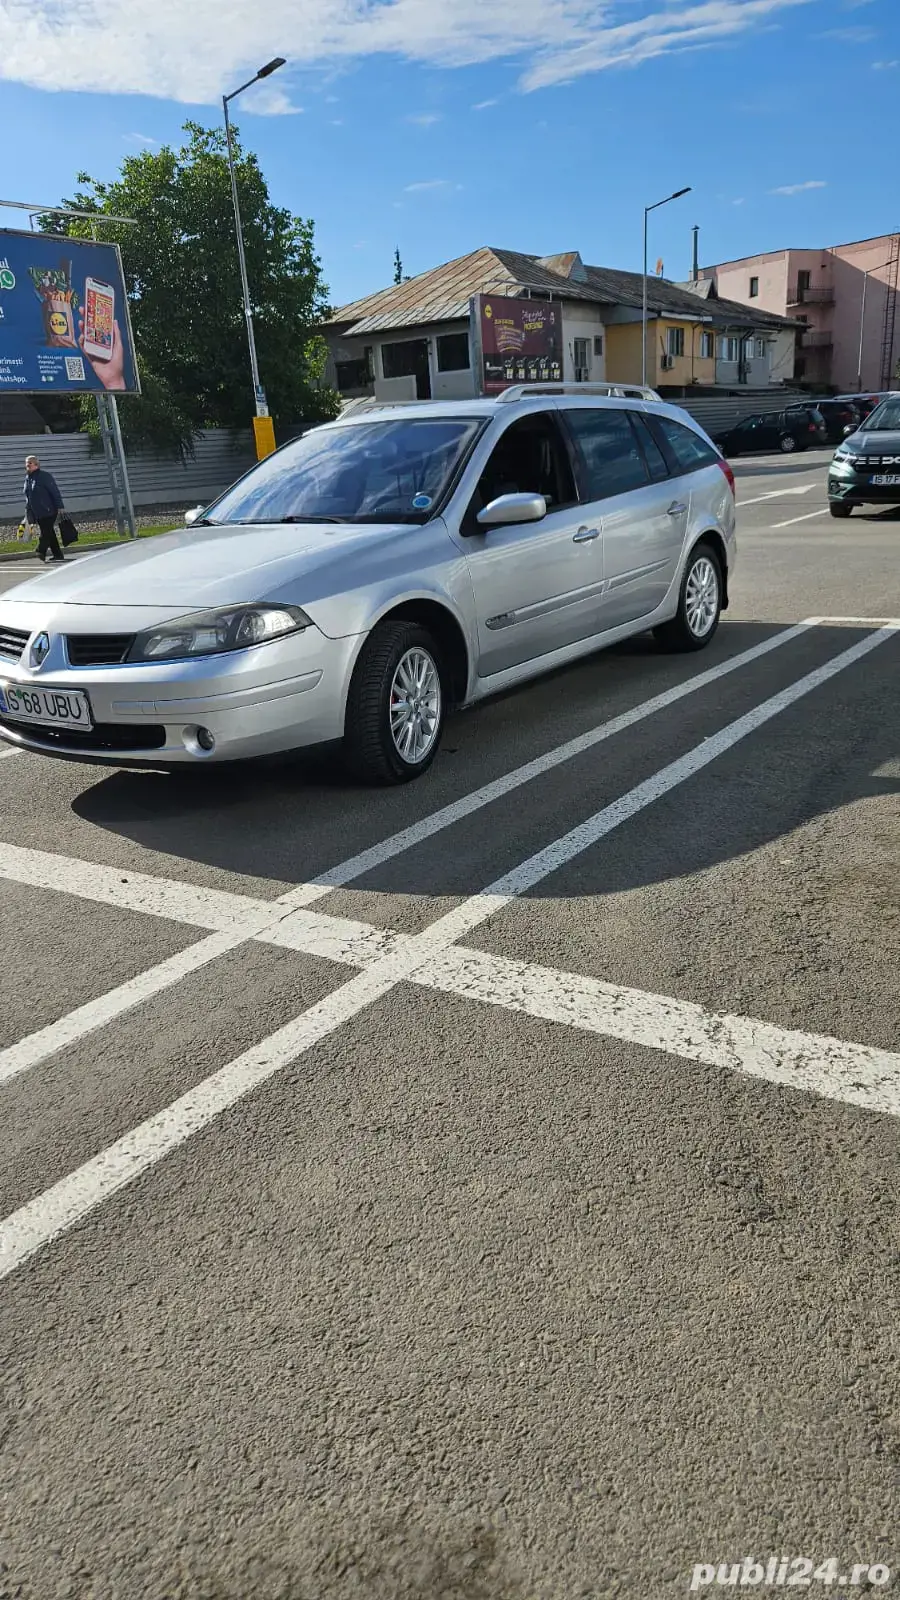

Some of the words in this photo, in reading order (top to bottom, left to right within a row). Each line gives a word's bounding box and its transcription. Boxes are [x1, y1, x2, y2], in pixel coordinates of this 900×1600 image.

[875, 475, 883, 484] IS
[886, 475, 894, 484] 17
[5, 688, 20, 711] IS
[21, 691, 42, 714] 68
[43, 693, 82, 719] UBU
